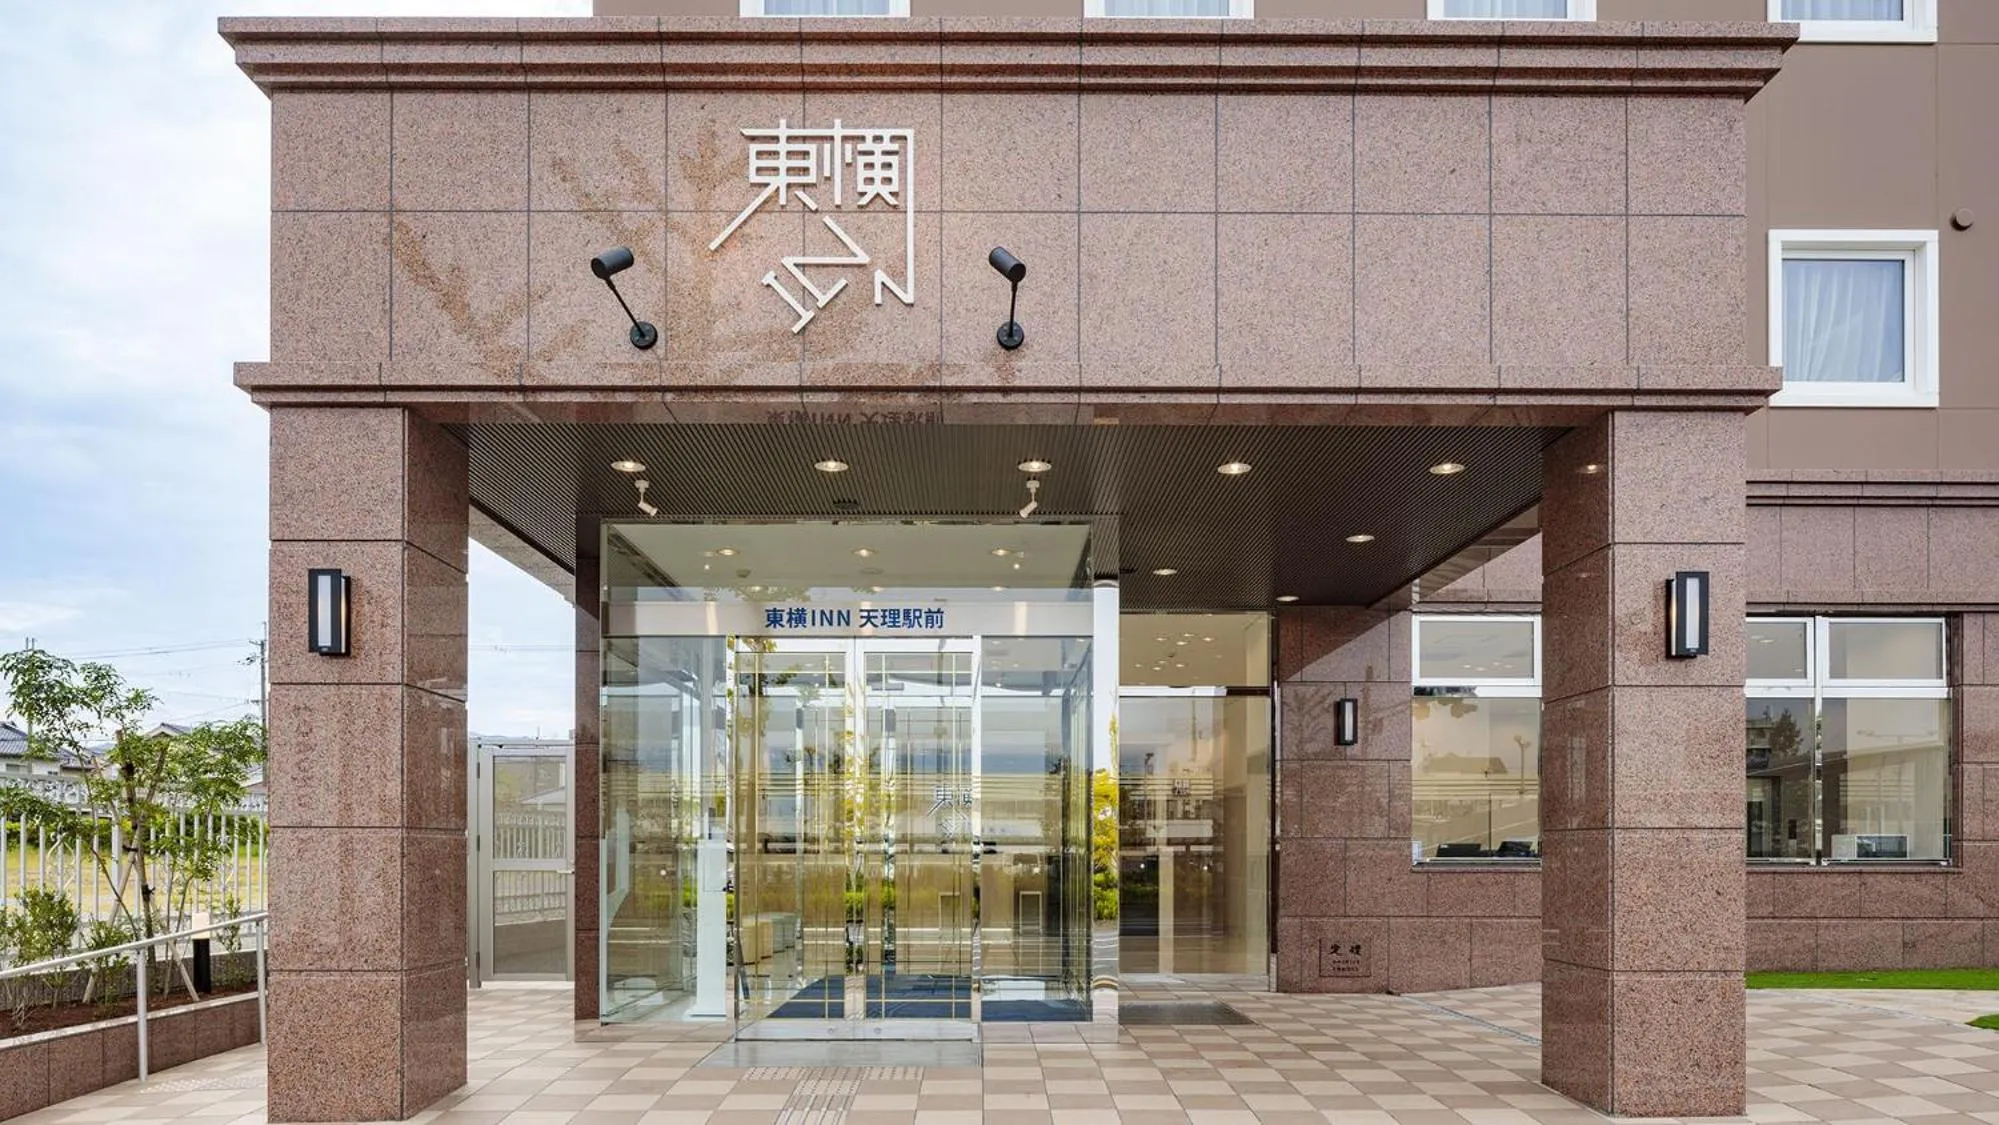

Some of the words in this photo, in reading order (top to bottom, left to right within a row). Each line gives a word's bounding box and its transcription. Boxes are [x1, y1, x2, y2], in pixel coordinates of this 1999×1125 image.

[764, 607, 850, 629] 東横INN
[859, 607, 945, 629] 天理駅前
